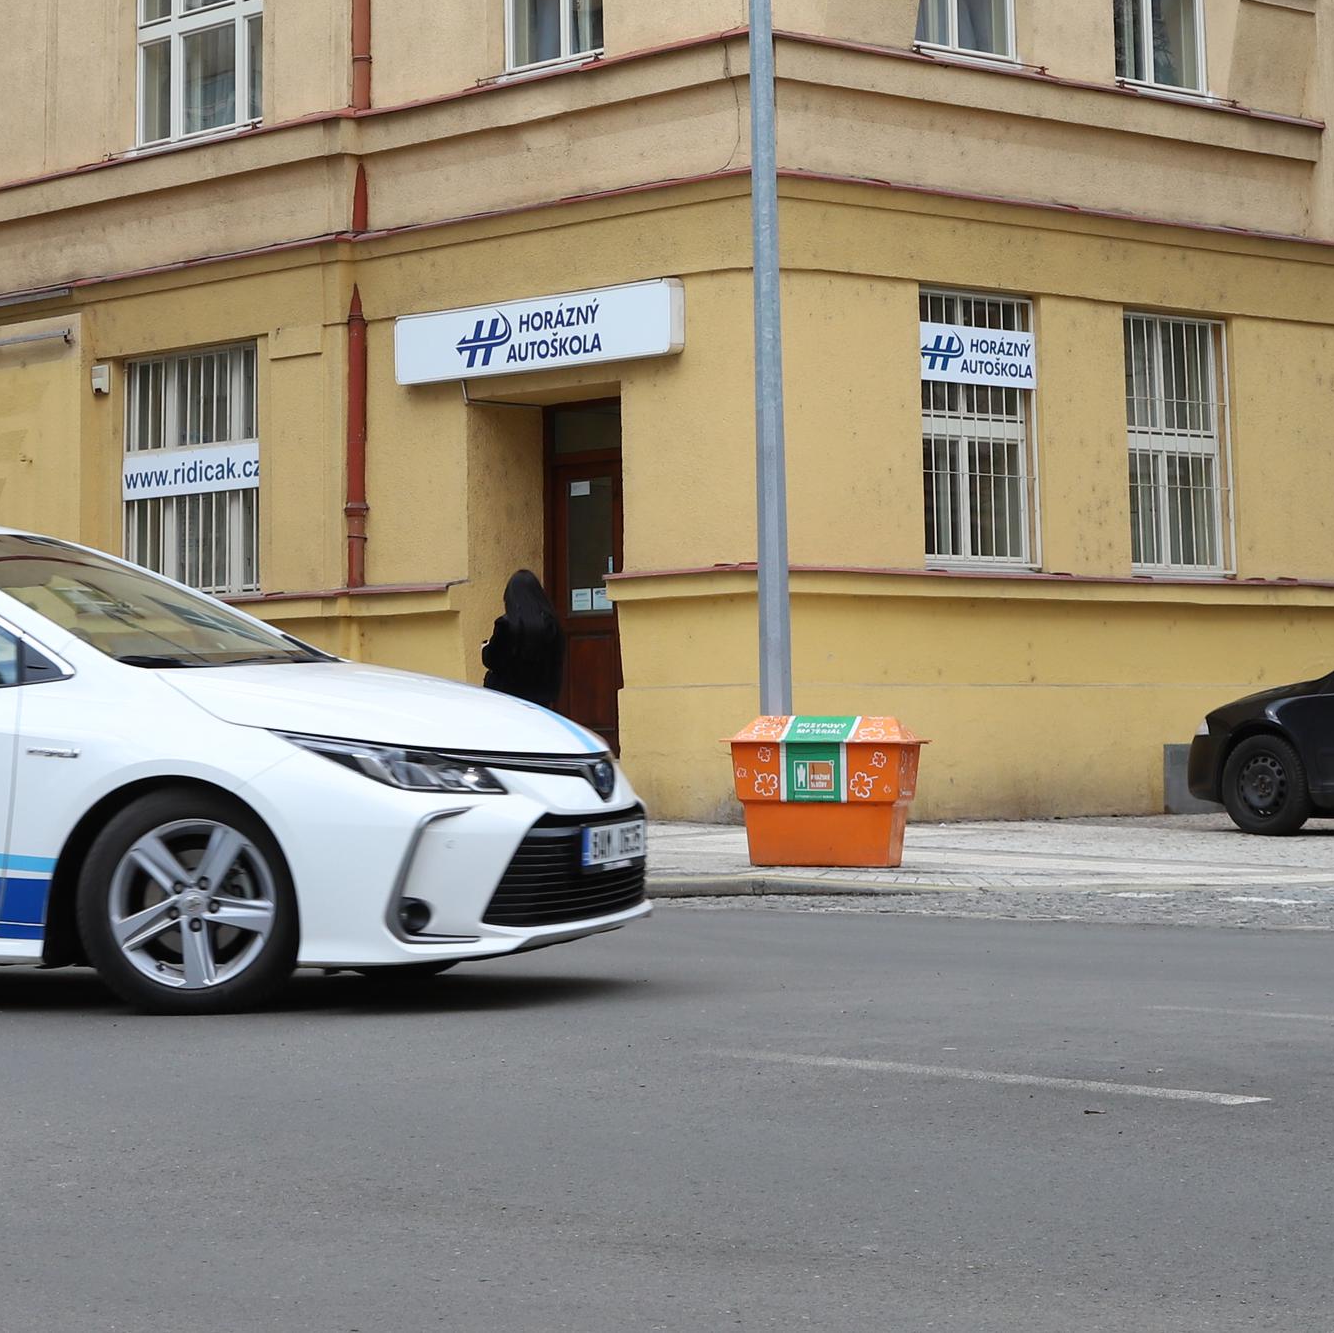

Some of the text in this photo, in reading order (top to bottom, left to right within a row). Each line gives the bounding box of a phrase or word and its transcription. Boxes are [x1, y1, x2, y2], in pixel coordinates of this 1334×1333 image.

[519, 298, 600, 333] HORÁZNÝ
[506, 332, 602, 363] AUTOŠKOLA
[970, 337, 1031, 358] HORÁZNÝ
[960, 357, 1033, 379] AUTOŠKOLA
[125, 457, 259, 489] www.ridicak.cz
